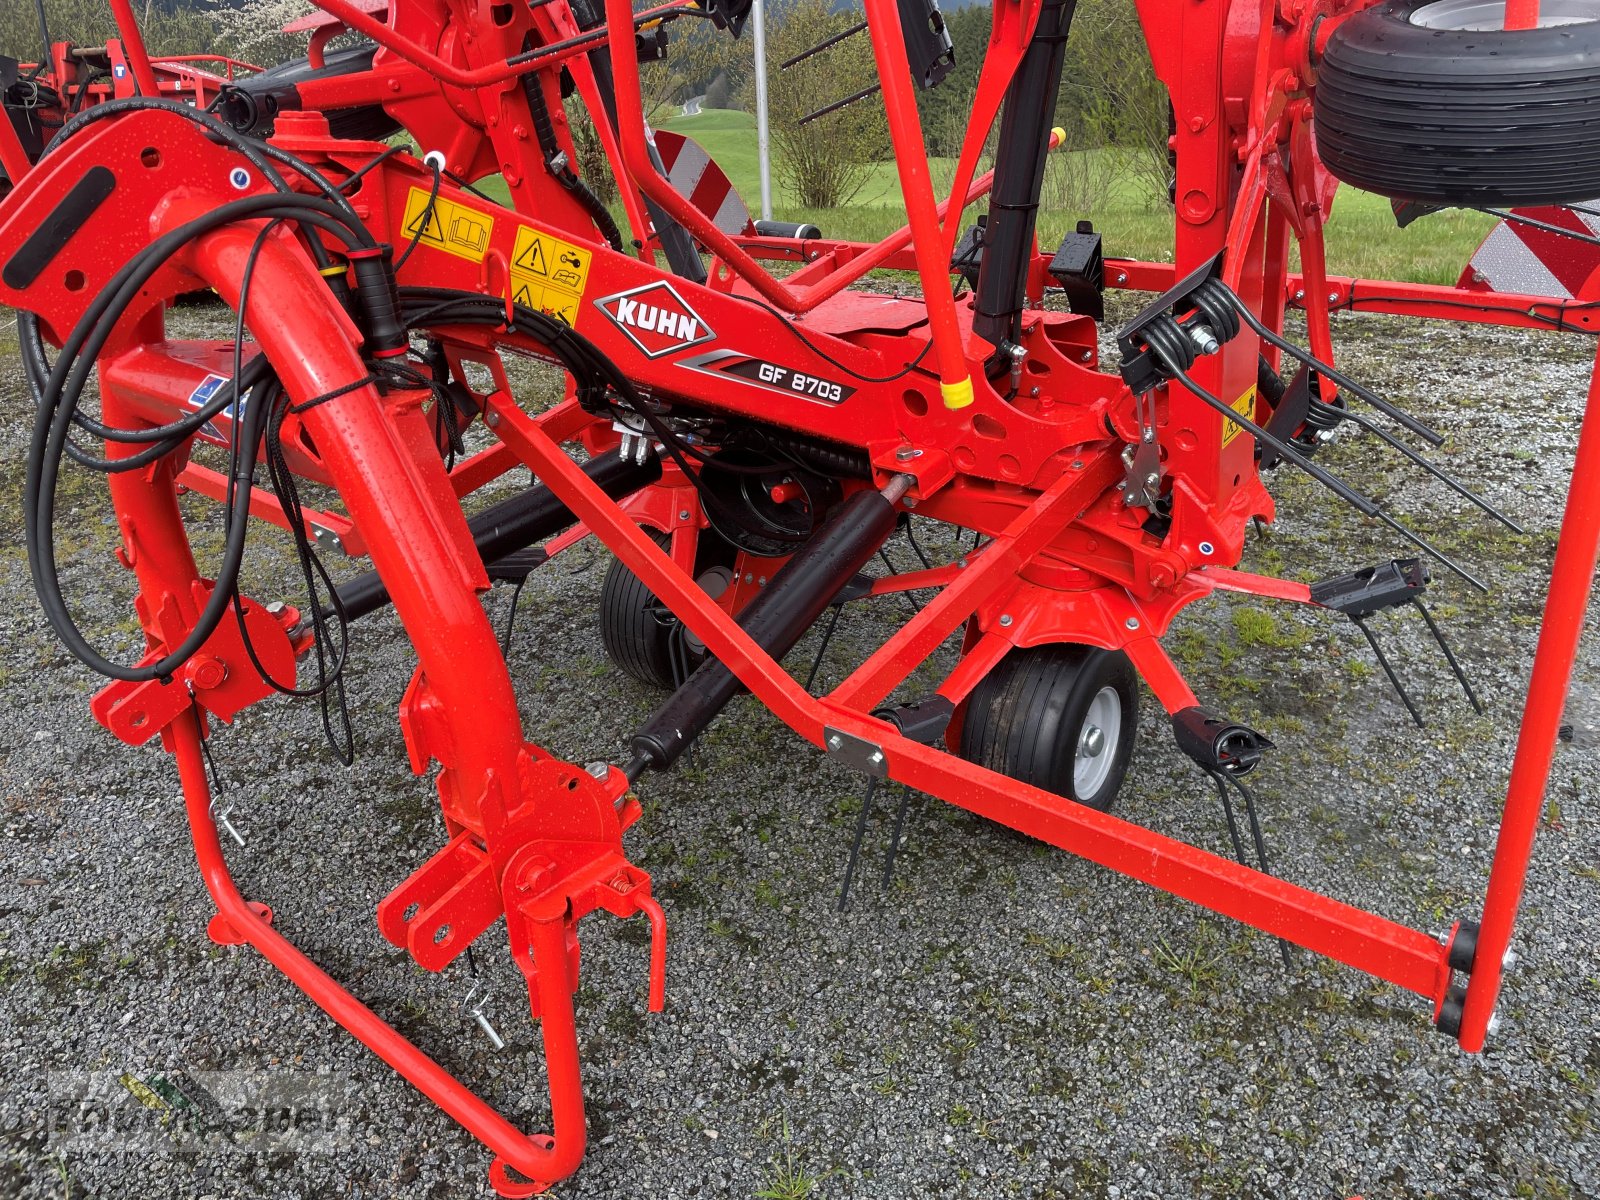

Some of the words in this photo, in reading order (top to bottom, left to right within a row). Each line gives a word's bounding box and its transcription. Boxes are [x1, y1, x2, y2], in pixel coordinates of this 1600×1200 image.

[616, 297, 698, 342] KUHN
[758, 364, 787, 383] GF
[791, 373, 842, 402] 8703
